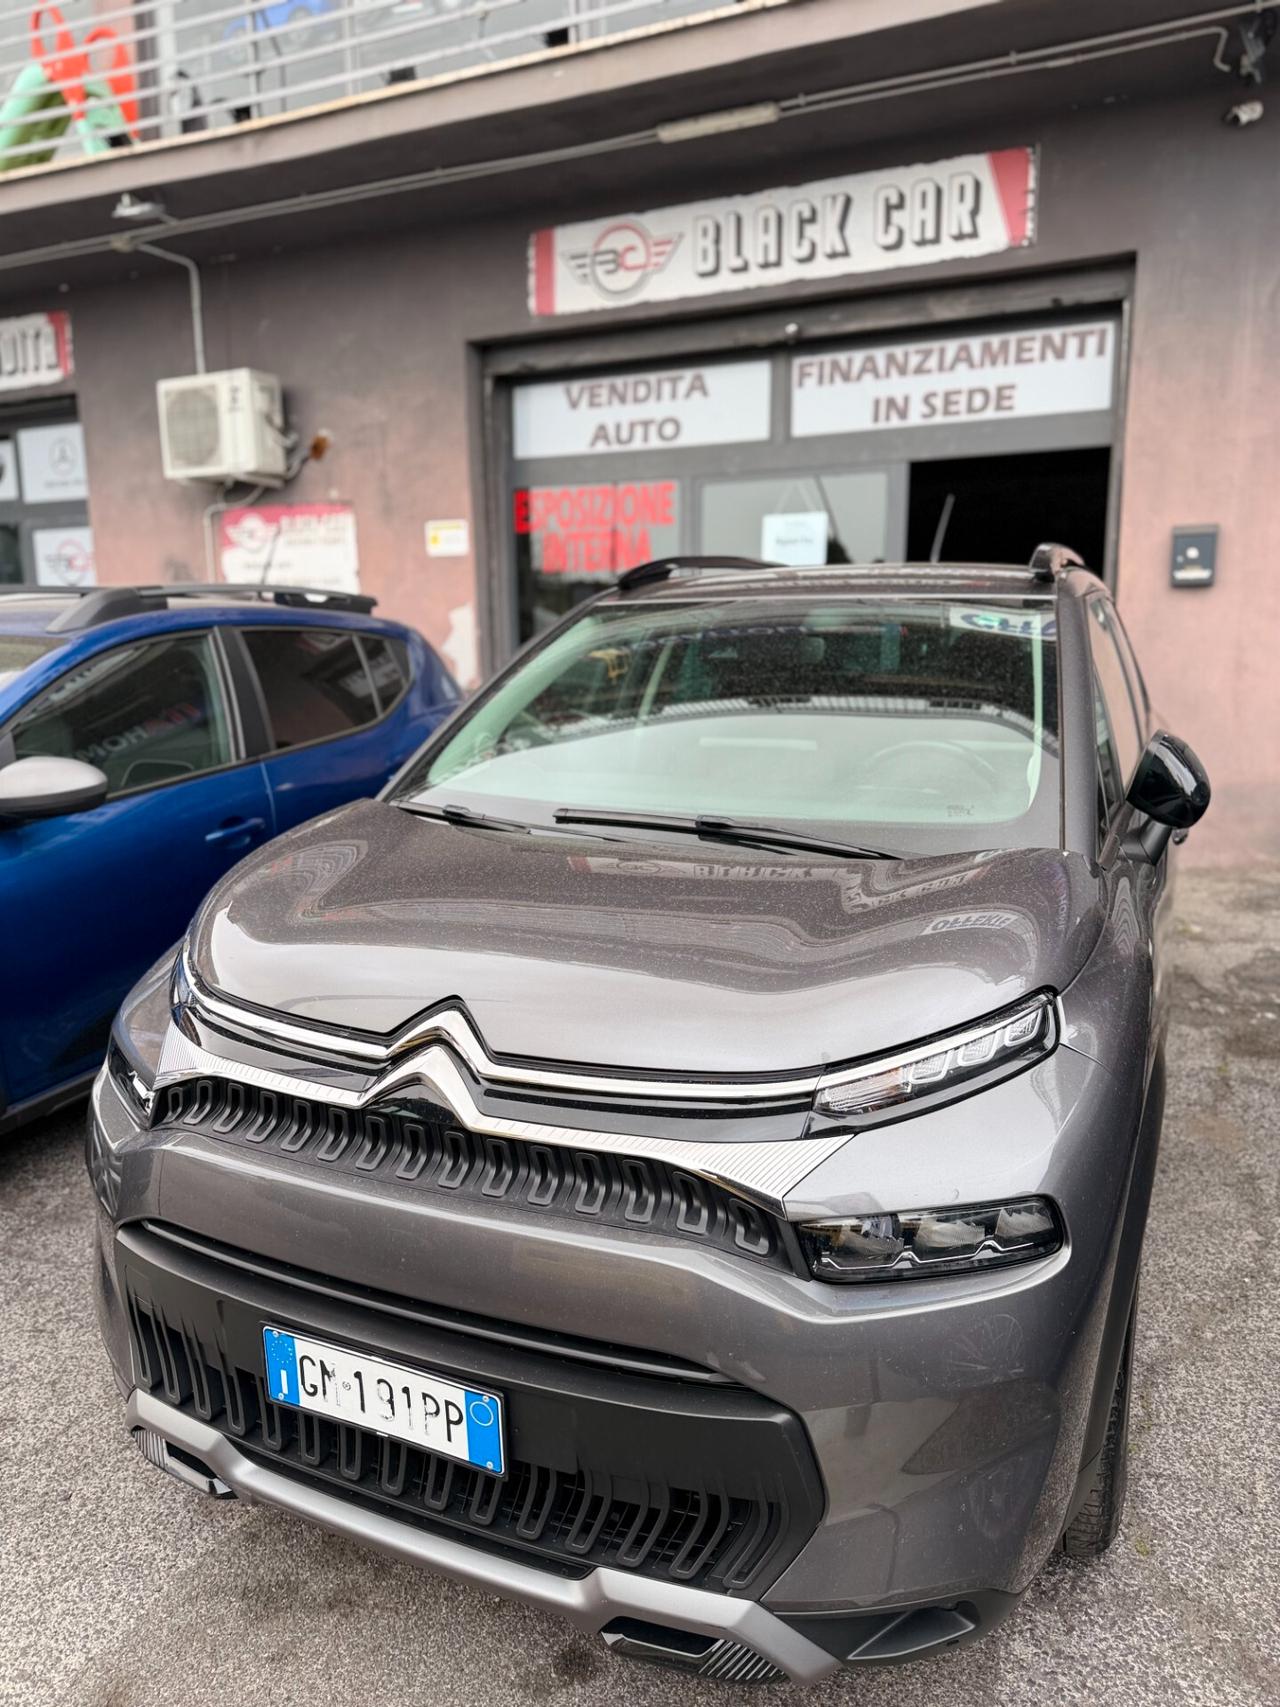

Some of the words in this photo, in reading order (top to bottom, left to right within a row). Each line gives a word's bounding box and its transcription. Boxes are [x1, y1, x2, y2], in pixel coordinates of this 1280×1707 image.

[694, 191, 853, 278] BLACK
[873, 171, 981, 251] CAR
[796, 327, 1108, 389] FINANZIAMENTI
[564, 370, 709, 411] VENDITA
[871, 395, 911, 424] IN
[921, 384, 1017, 419] SEDE
[589, 417, 681, 448] AUTO
[514, 481, 676, 534] ESPOSIZIONE
